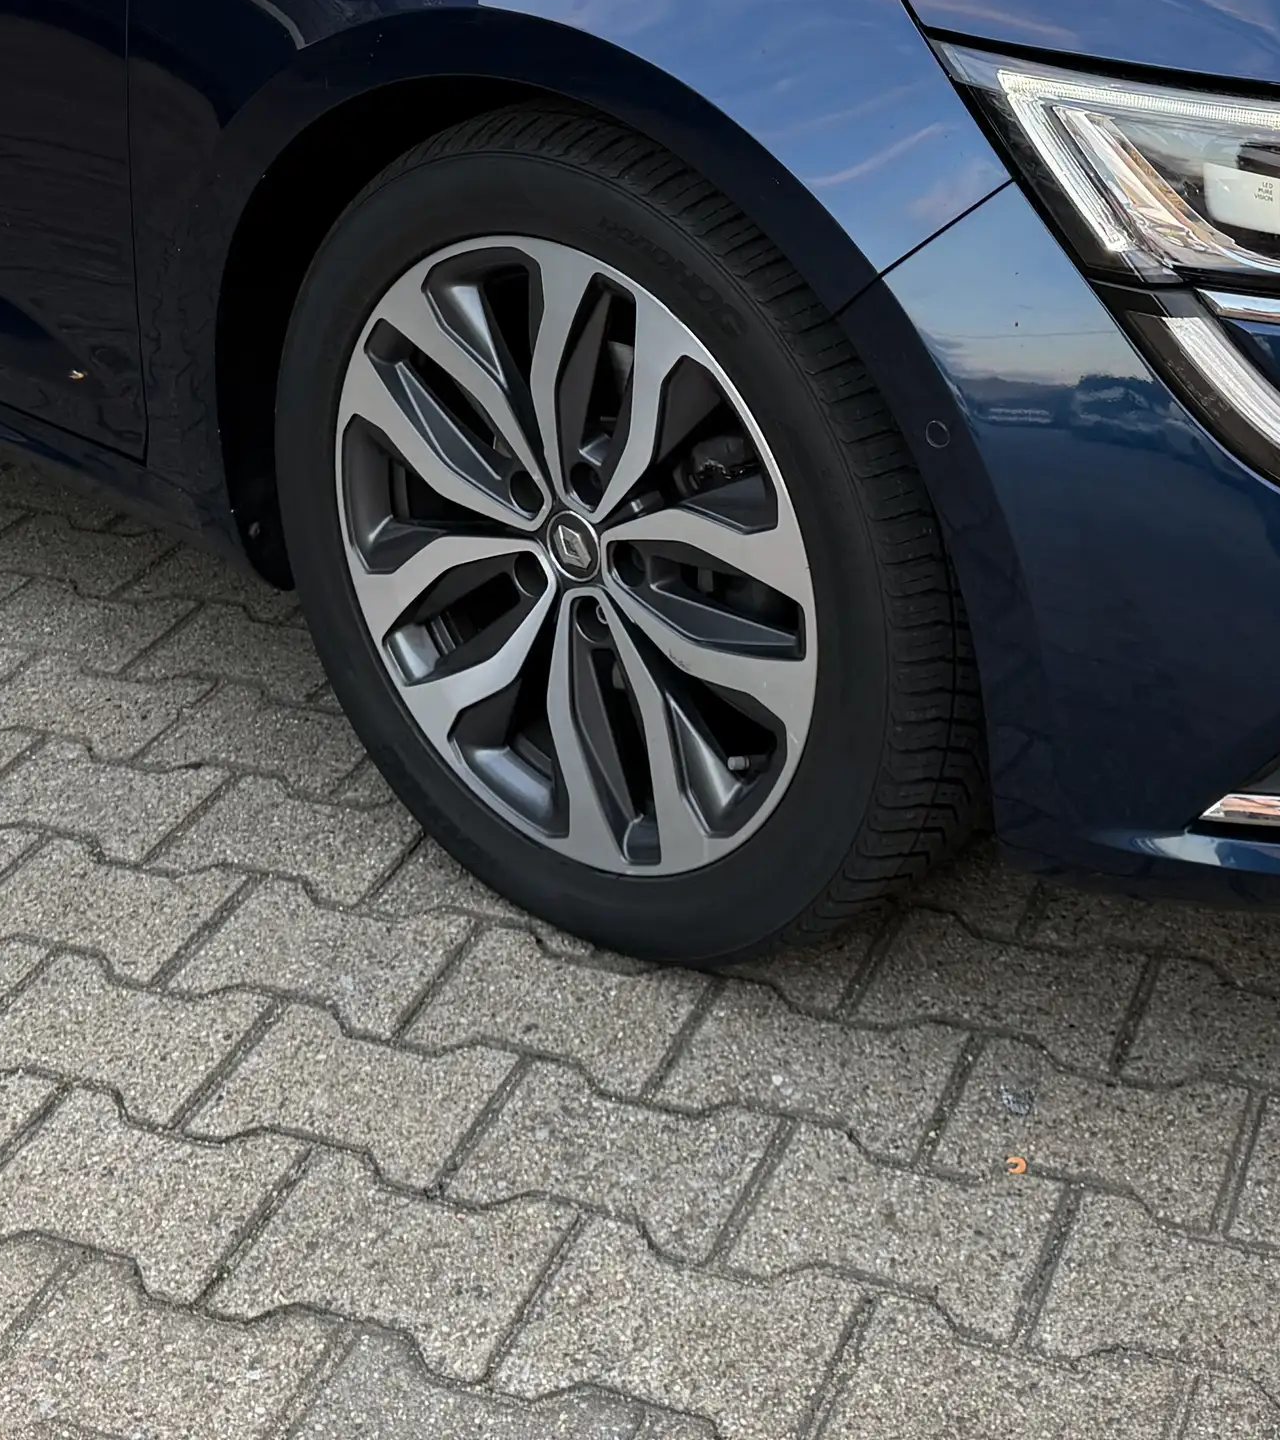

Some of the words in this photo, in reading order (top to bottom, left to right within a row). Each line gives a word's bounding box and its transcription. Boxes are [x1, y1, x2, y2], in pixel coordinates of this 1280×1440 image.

[1262, 181, 1273, 189] LED
[1258, 187, 1273, 196] PURE
[1253, 192, 1274, 202] VISION
